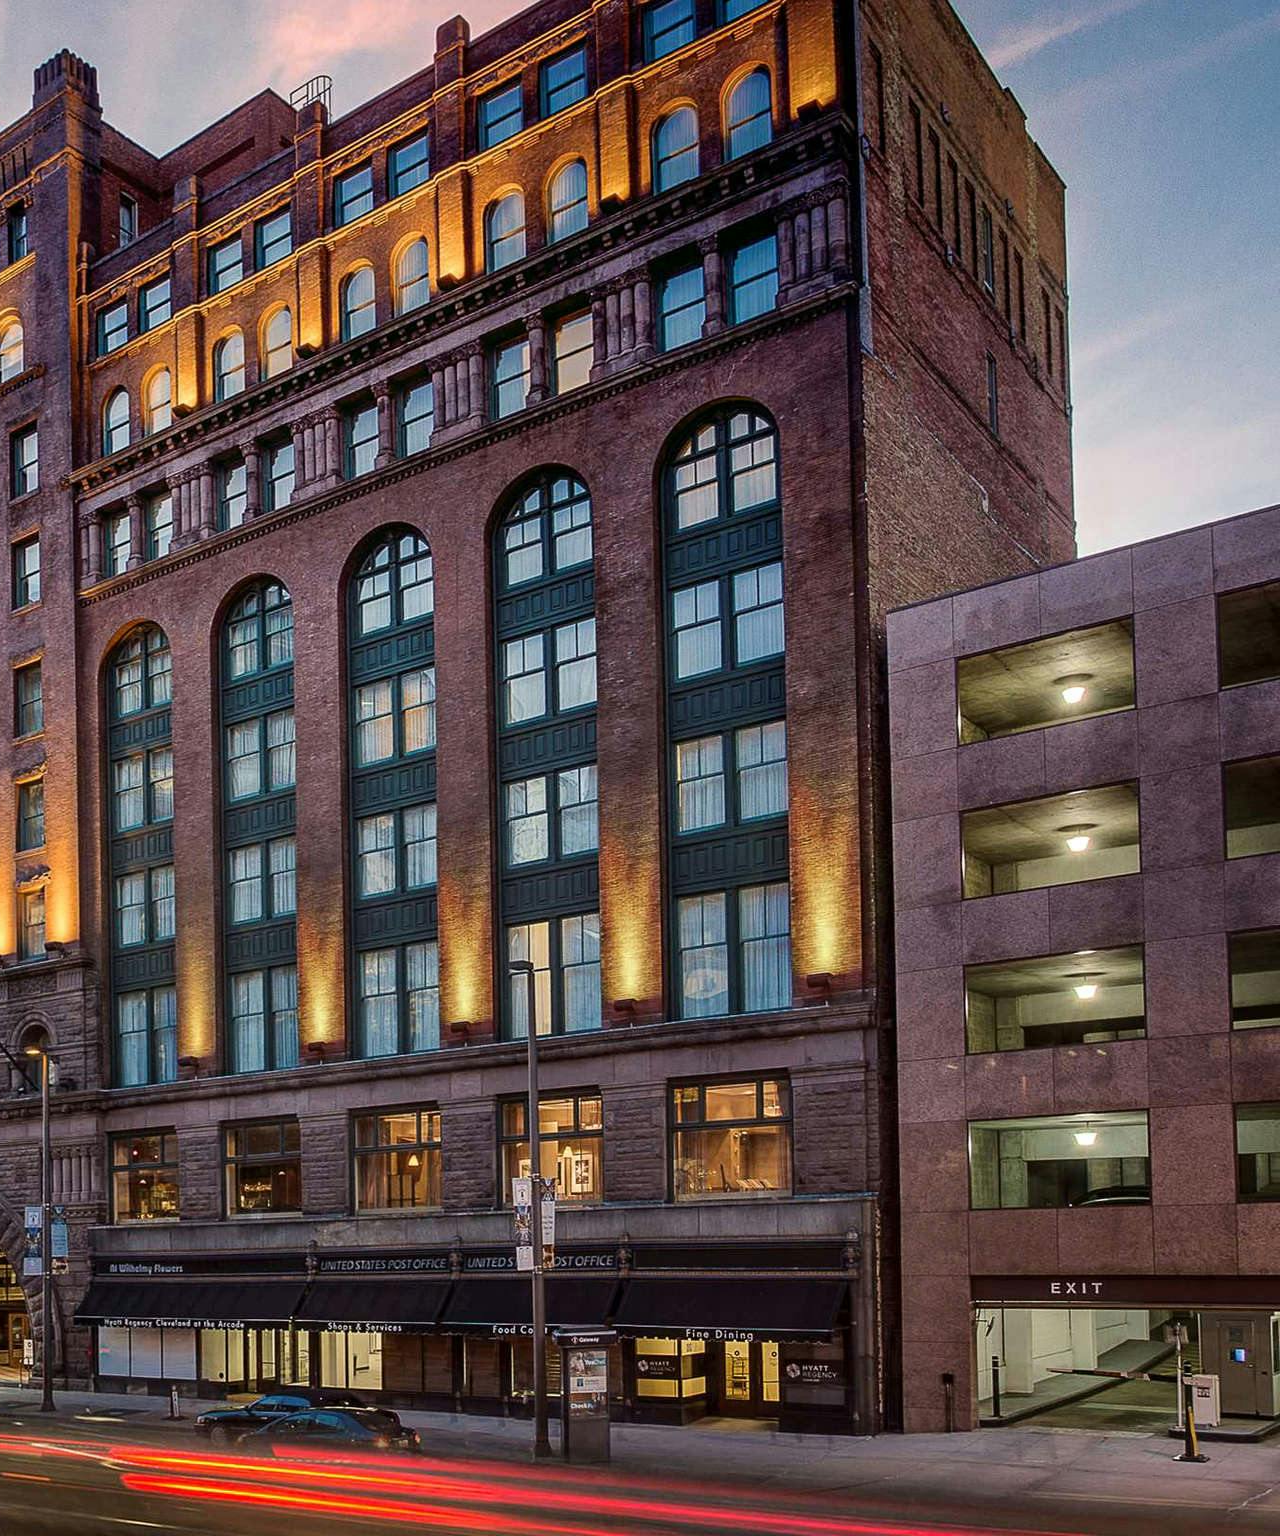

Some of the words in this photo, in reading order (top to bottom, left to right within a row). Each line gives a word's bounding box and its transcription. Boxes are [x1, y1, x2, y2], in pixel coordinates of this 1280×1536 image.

[321, 1260, 355, 1271] UNITED
[355, 1259, 387, 1271] STATES
[388, 1259, 412, 1270] POST
[412, 1258, 447, 1269] OFFICE
[467, 1257, 507, 1268] UNITED
[575, 1255, 614, 1267] OFFICE
[1050, 1282, 1103, 1294] EXIT
[124, 1318, 153, 1328] Regency
[155, 1318, 191, 1328] Cleveland
[193, 1320, 202, 1328] at
[203, 1320, 215, 1328] the
[217, 1320, 245, 1329] Arcade
[365, 1323, 402, 1332] Services
[492, 1325, 516, 1334] Food
[685, 1329, 710, 1339] Fine
[715, 1329, 754, 1342] Dining
